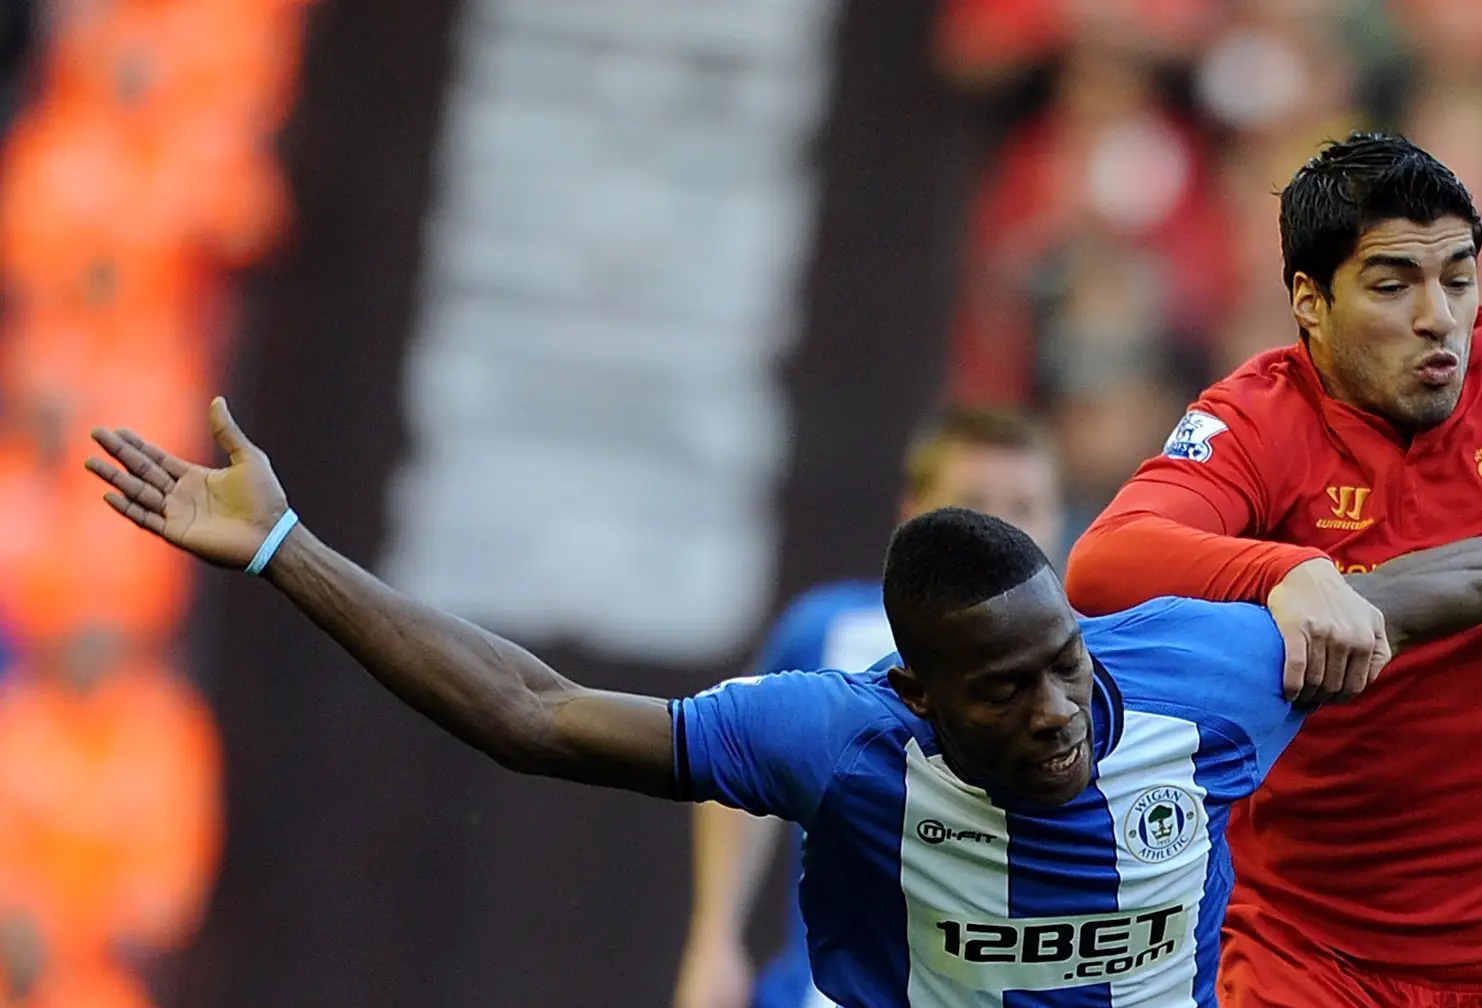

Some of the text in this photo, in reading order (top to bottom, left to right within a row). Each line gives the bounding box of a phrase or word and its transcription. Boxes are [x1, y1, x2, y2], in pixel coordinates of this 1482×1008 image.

[1135, 789, 1182, 813] WIGAN
[1139, 835, 1189, 860] ATHLETIC
[936, 904, 1183, 964] 12BET
